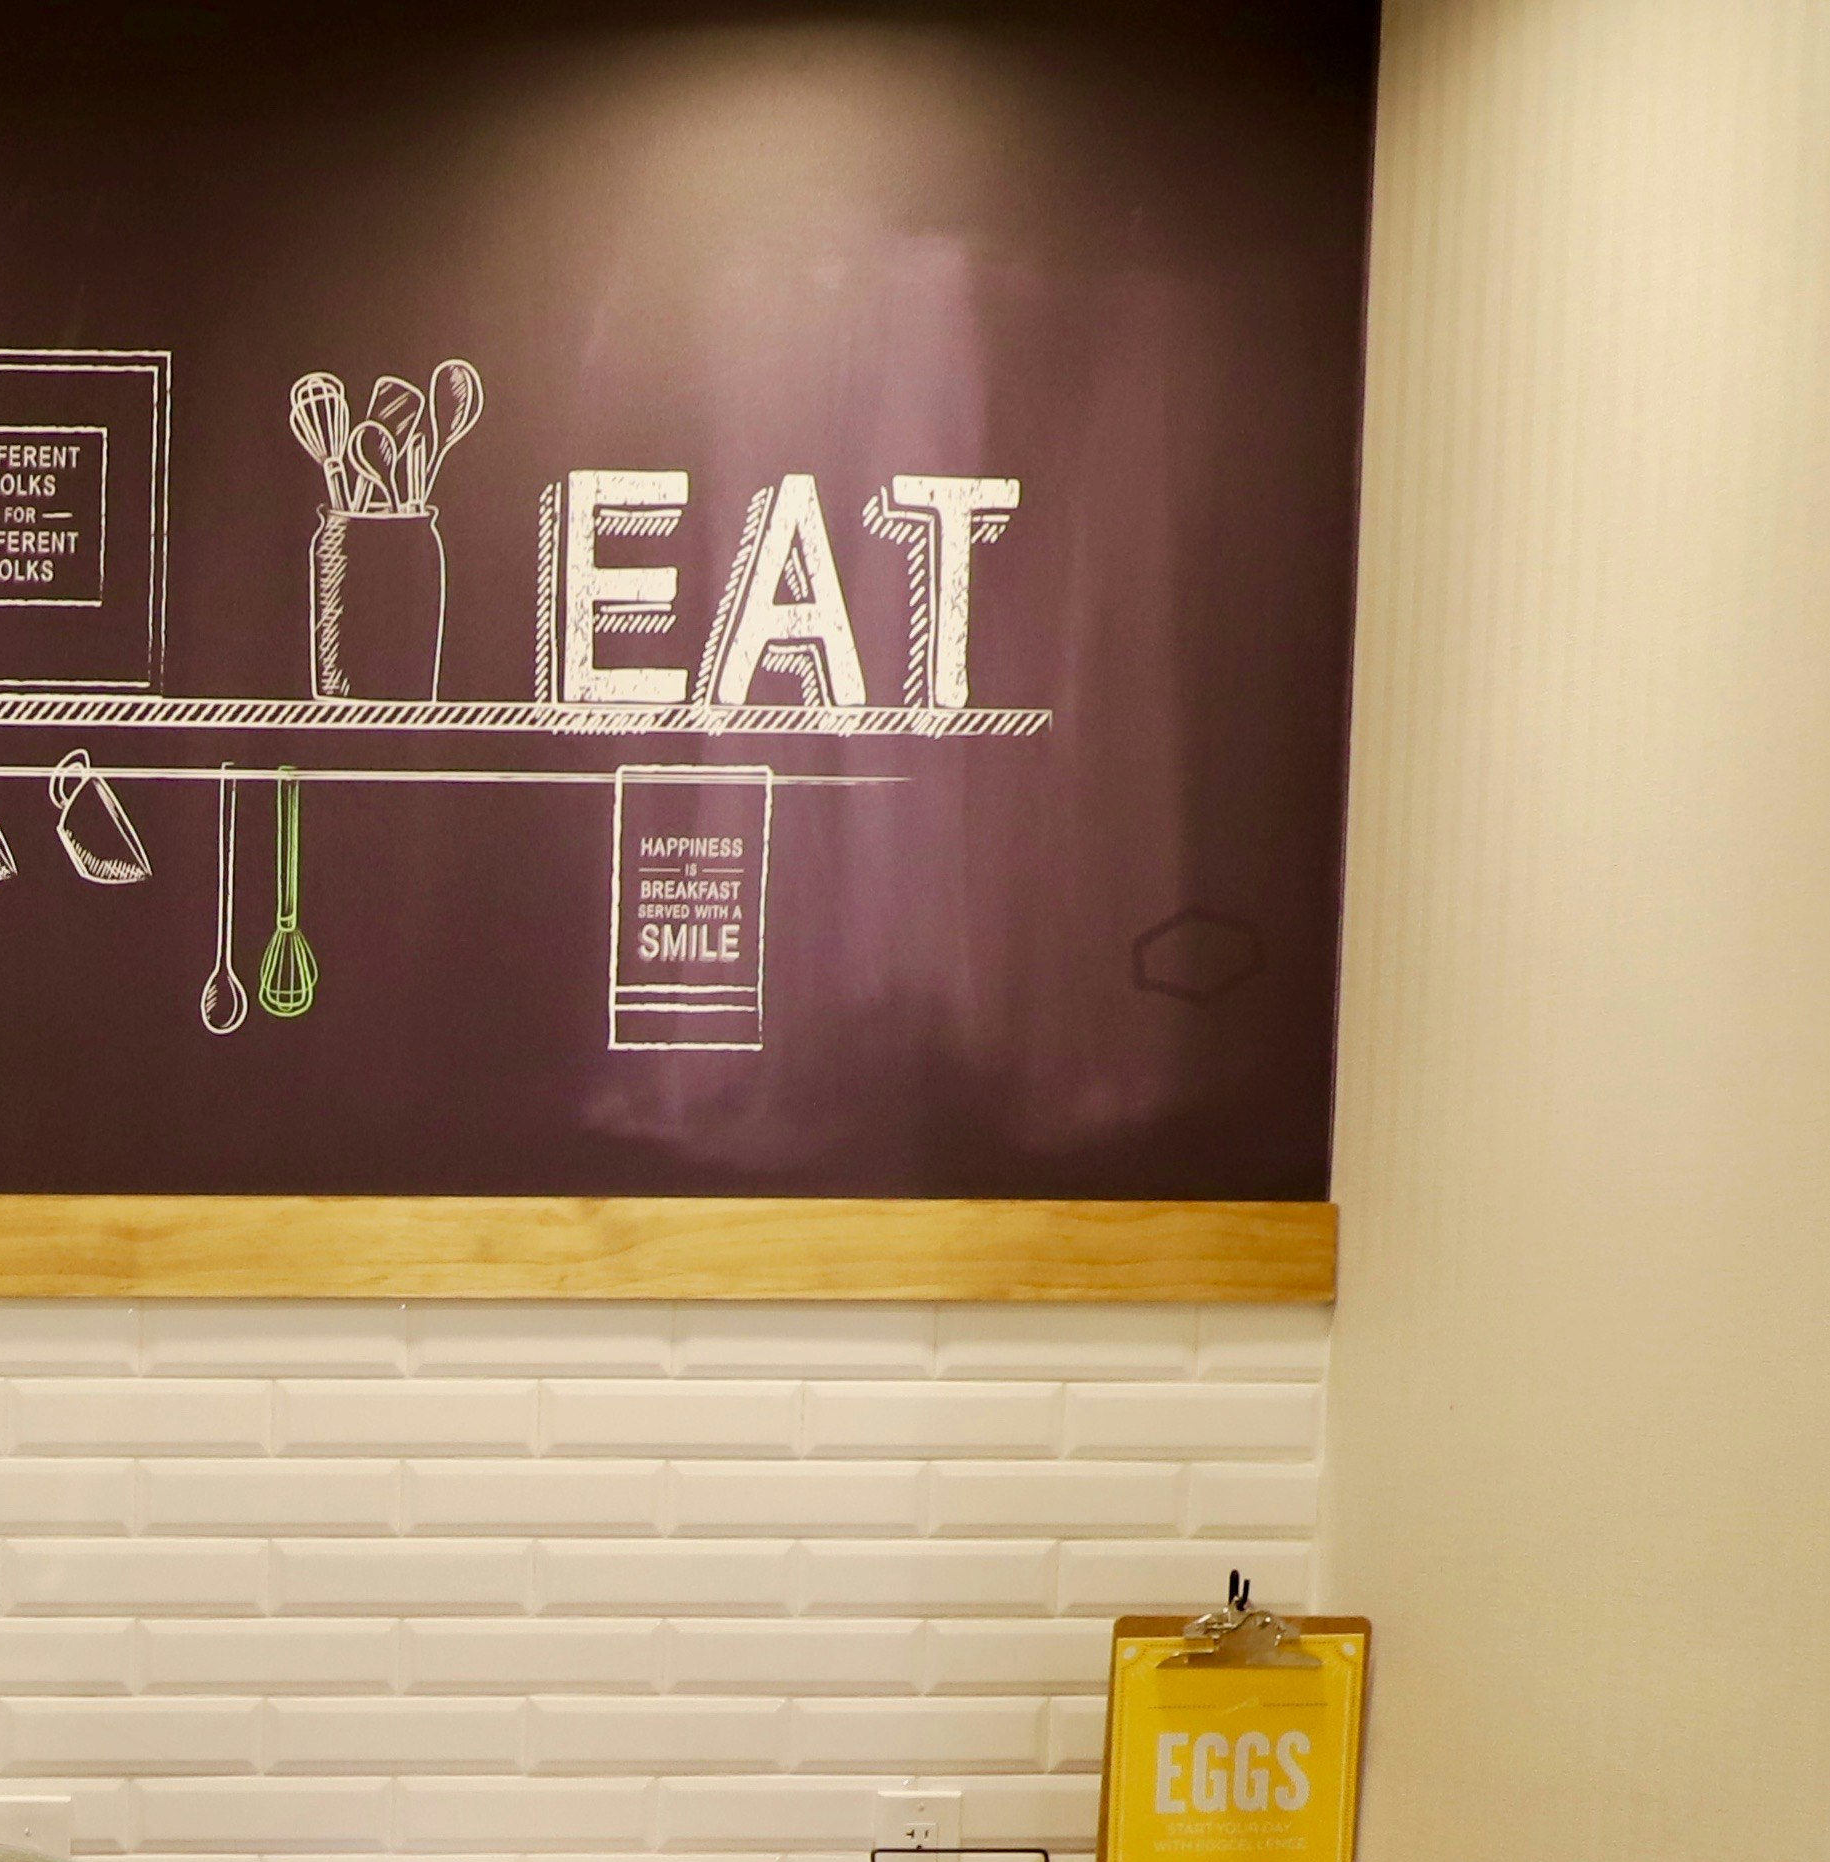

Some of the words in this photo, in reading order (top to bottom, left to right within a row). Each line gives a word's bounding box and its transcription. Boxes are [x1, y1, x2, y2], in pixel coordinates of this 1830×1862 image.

[3, 506, 37, 524] FOR
[537, 468, 1022, 708] EAT
[639, 836, 744, 859] HAPPINESS
[684, 863, 698, 877] IS
[640, 880, 741, 901] BREAKFAST
[637, 903, 690, 920] SERVED
[694, 903, 728, 920] WITH
[732, 904, 743, 921] A
[638, 923, 741, 963] SMILE
[1153, 1729, 1312, 1815] EGGS
